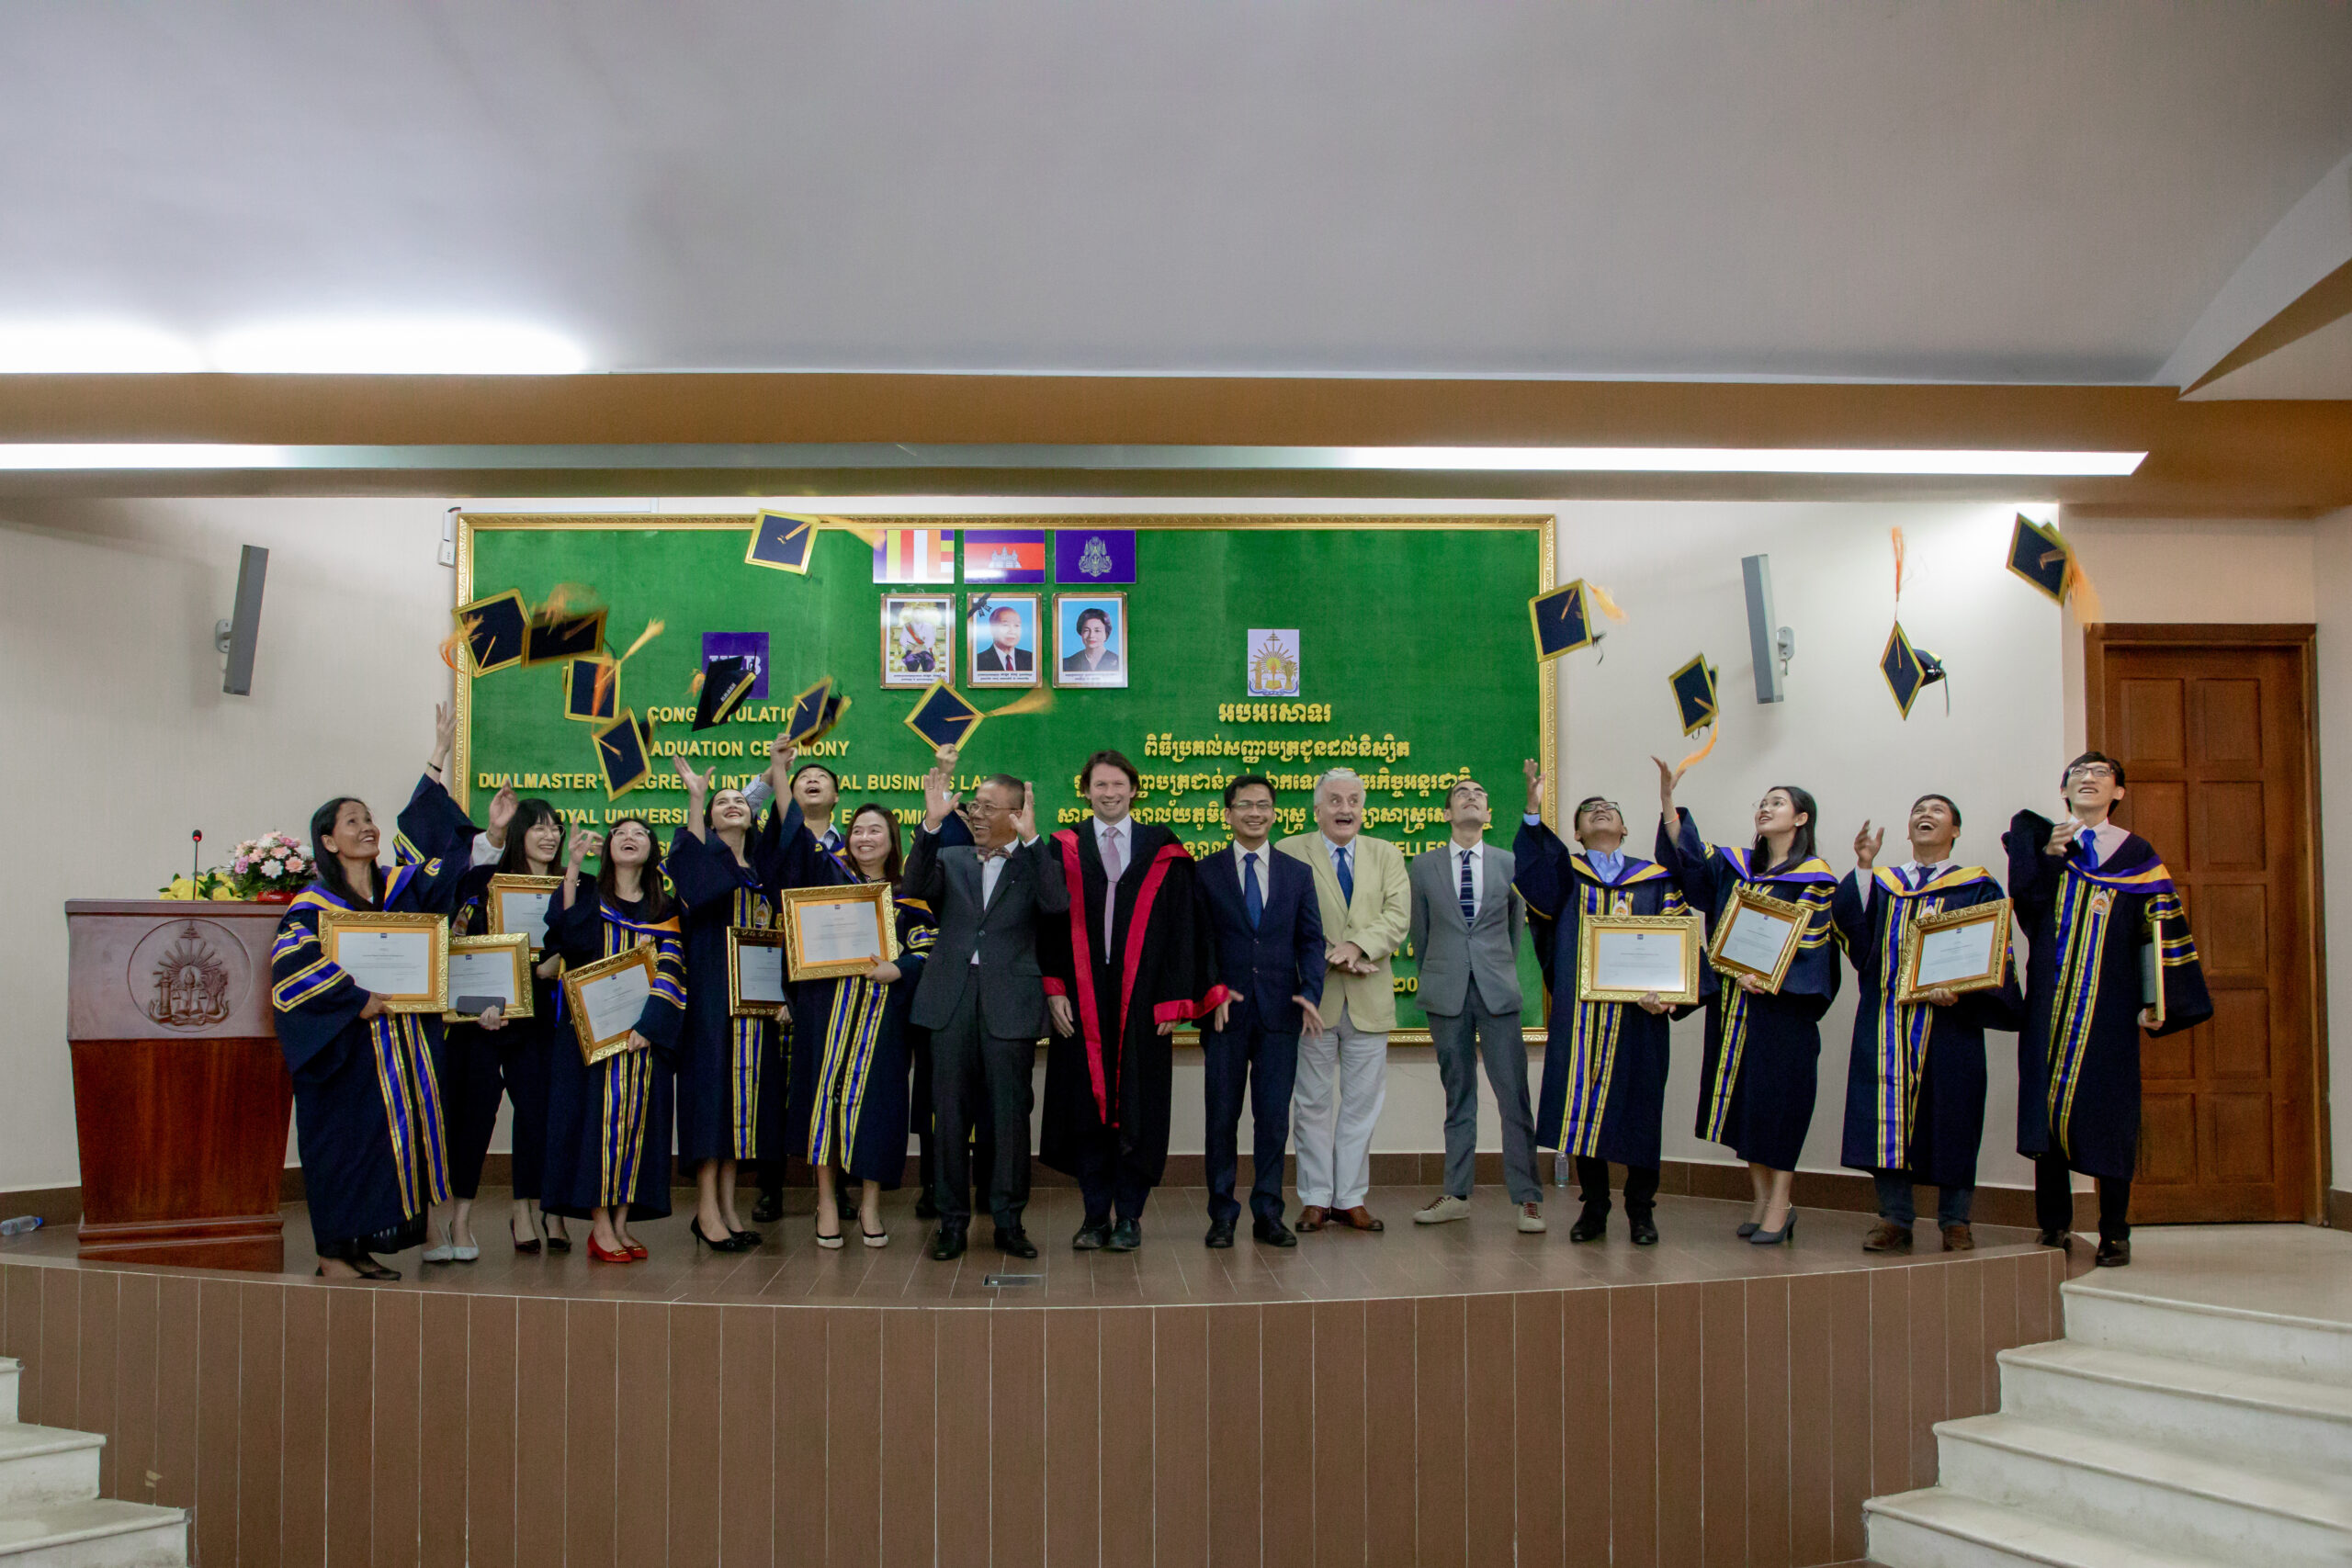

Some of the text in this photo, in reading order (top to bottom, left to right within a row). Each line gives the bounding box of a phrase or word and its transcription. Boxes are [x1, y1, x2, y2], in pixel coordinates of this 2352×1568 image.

[1218, 703, 1331, 723] អបអរសាទរ
[650, 740, 851, 757] ADUATION CEMONY
[866, 774, 956, 791] BUSINS
[959, 774, 988, 791] LA
[554, 808, 690, 825] OYAL UNIVERSI
